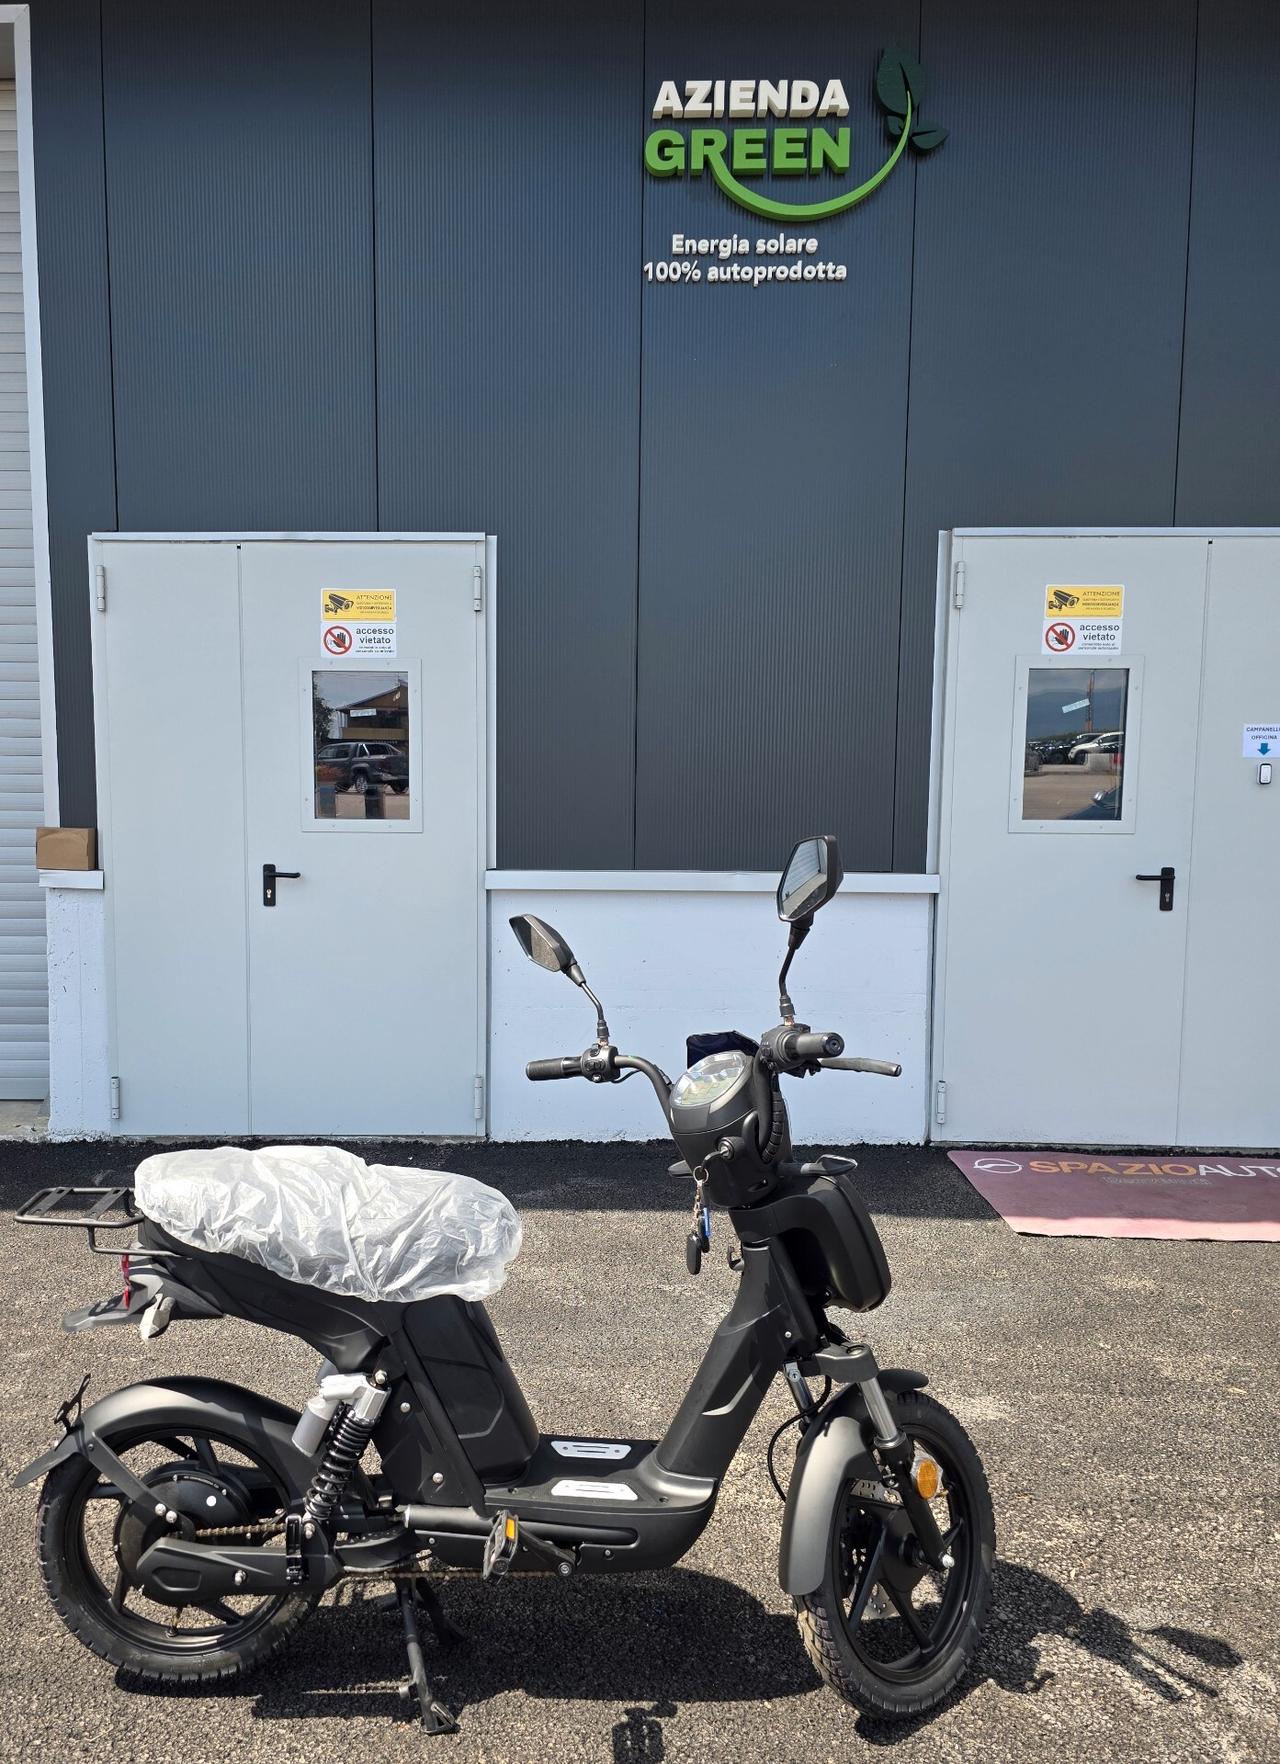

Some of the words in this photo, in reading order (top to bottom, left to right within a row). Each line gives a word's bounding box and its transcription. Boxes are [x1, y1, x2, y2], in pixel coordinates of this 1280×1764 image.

[652, 79, 850, 119] AZIENDA
[644, 127, 851, 177] GREEN
[672, 234, 749, 259] Energia
[755, 233, 818, 253] solare
[643, 260, 701, 282] 100%
[707, 260, 847, 286] autoprodotta
[356, 627, 394, 635] accesso
[359, 636, 391, 644] vietato
[1082, 632, 1116, 641] vietato
[1029, 1160, 1280, 1178] SPAZIOAUT
